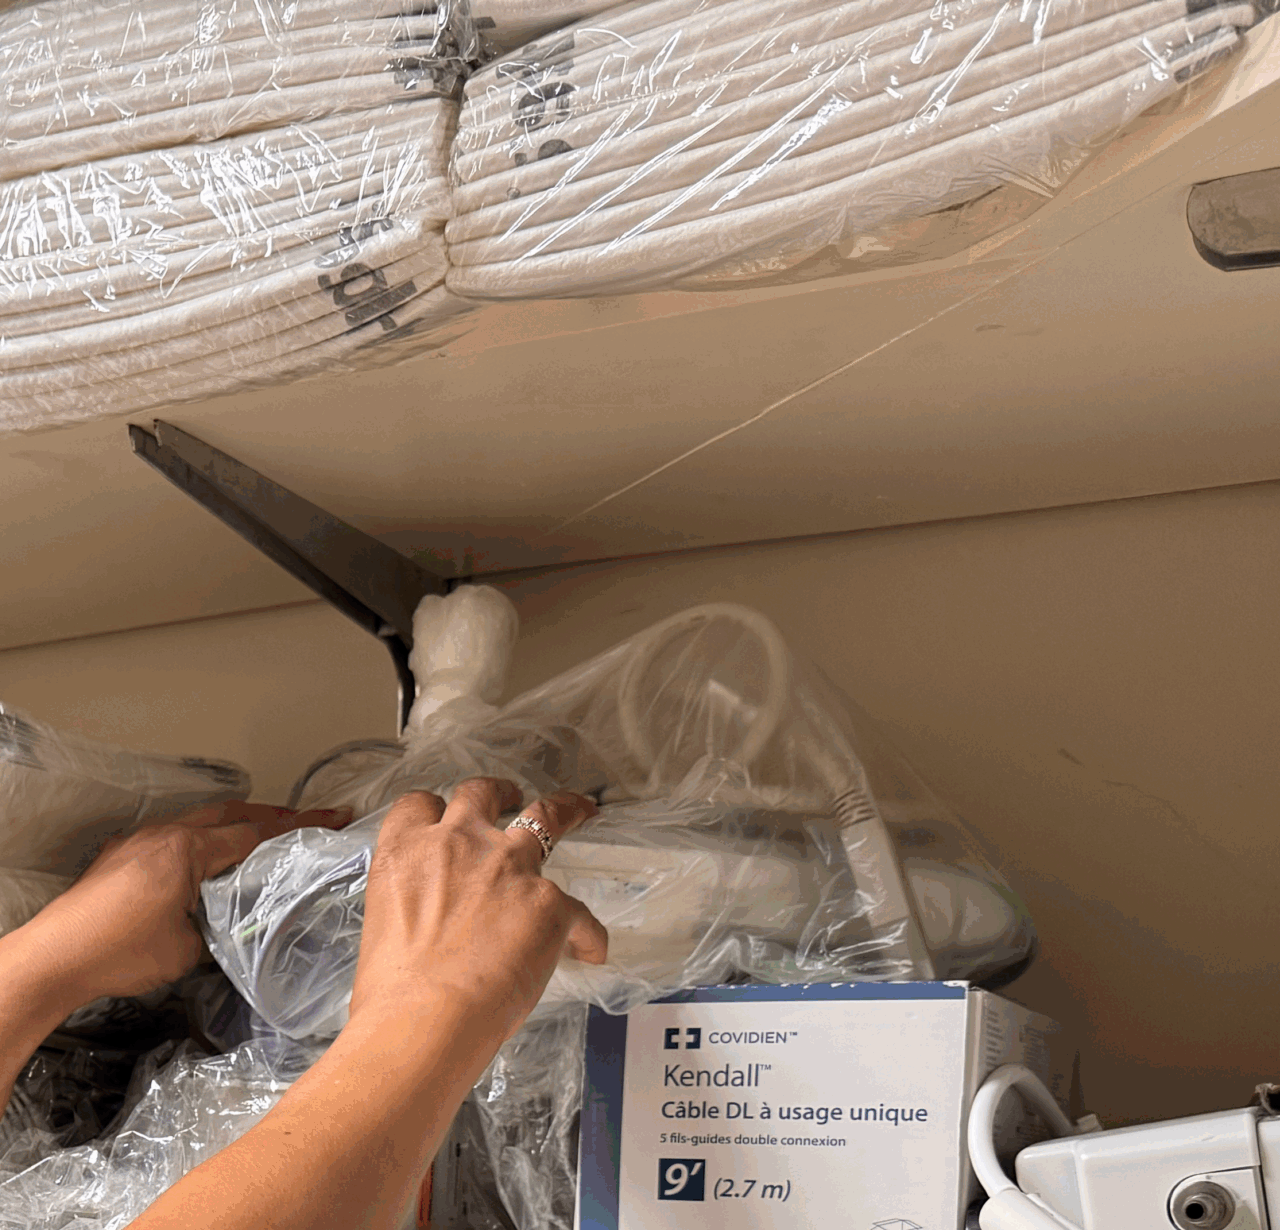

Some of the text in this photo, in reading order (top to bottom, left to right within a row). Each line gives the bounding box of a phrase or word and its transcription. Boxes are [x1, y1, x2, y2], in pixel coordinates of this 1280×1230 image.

[661, 1100, 928, 1126] Câble DL à usage unique
[659, 1132, 847, 1147] 5 fils-guides double connexion
[713, 1178, 756, 1200] (2.7
[761, 1180, 791, 1202] m)
